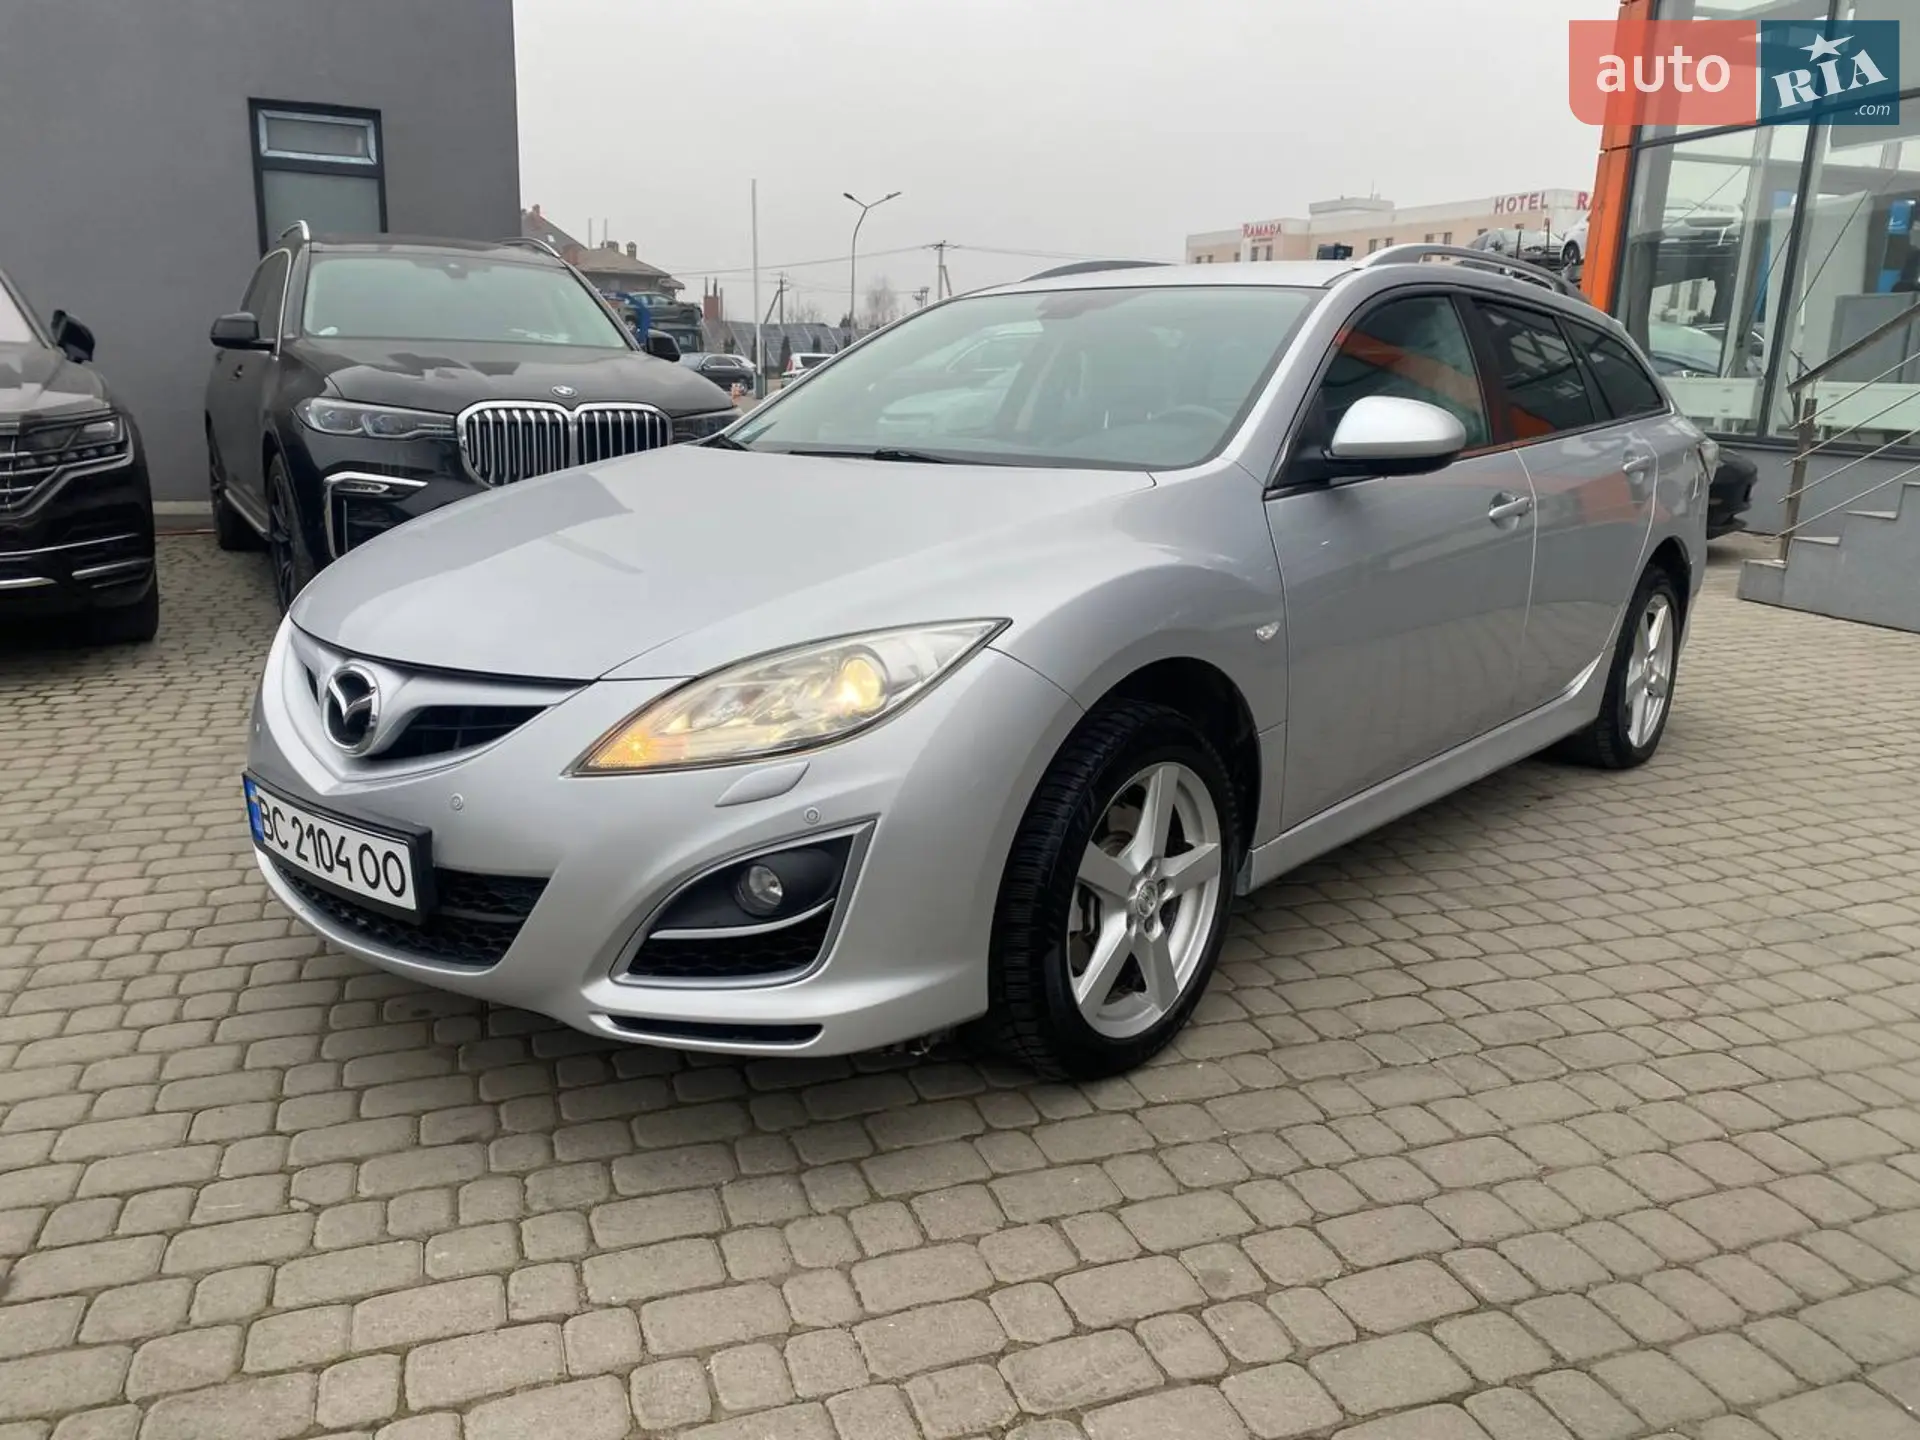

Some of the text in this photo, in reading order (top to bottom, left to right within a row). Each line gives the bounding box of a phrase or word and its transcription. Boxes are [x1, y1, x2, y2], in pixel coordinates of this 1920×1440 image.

[1495, 191, 1592, 214] HOTEL R
[257, 796, 289, 850] BC
[292, 815, 353, 882] 2104
